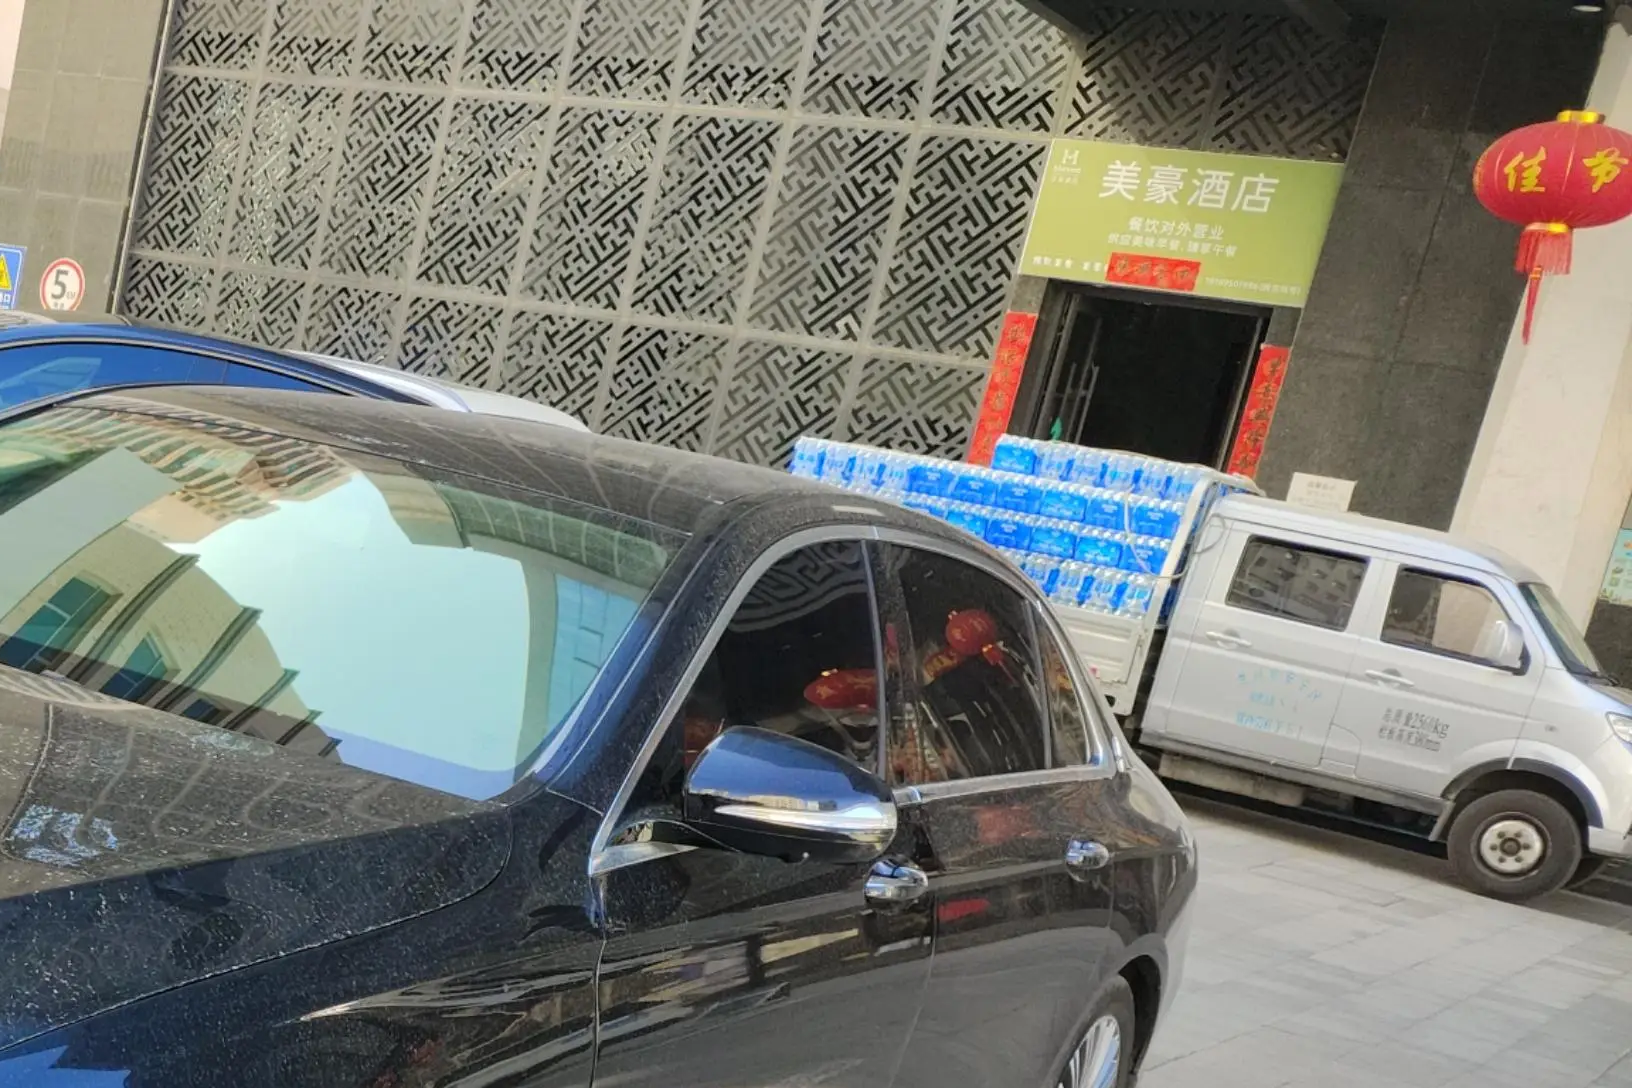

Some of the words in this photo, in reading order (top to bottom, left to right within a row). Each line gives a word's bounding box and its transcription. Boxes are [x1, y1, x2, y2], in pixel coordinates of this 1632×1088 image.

[1098, 160, 1280, 213] 美豪酒店
[1128, 216, 1225, 241] 餐饮对外营业
[51, 268, 70, 300] 5
